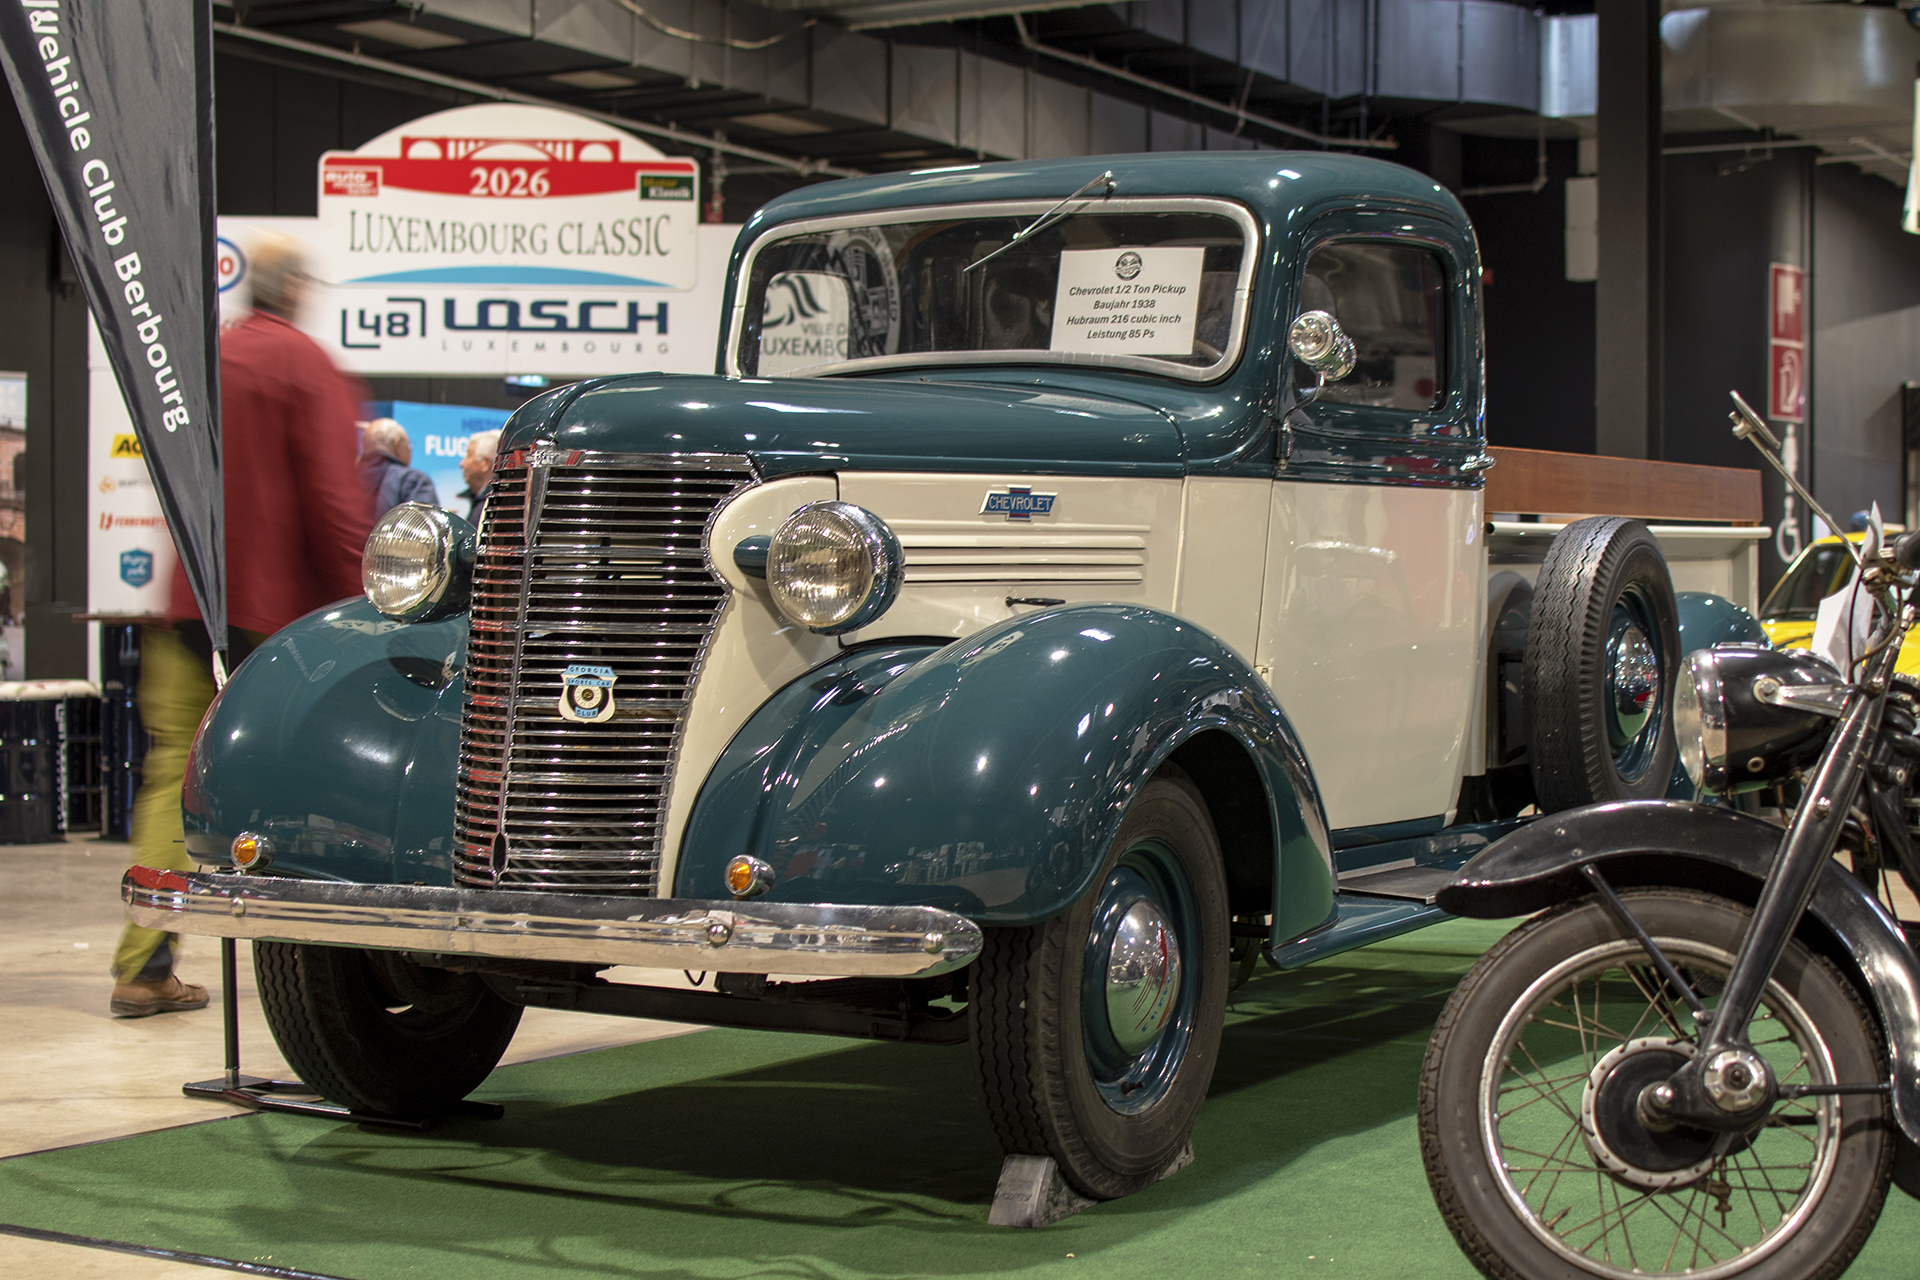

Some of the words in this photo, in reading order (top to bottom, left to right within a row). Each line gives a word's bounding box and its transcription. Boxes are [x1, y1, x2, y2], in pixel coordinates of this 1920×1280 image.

[468, 166, 551, 198] 2026
[649, 186, 692, 199] Klassik
[28, 10, 91, 152] Vehicle
[82, 159, 127, 246] Club
[114, 251, 190, 433] Berbourg
[349, 209, 548, 256] LUXEMBOURG
[557, 214, 672, 256] CLASSIC
[1069, 285, 1114, 296] Chevrolet
[1115, 284, 1132, 294] 1/2
[1133, 284, 1150, 294] Ton
[1152, 284, 1186, 296] Pickup
[1093, 299, 1130, 311] Baujahr
[1131, 299, 1156, 309] 1938
[443, 297, 669, 335] LOSCH
[1066, 315, 1109, 326] Hubraum
[1110, 314, 1129, 324] 216
[1130, 313, 1158, 324] cubic
[1158, 313, 1182, 324] inch
[800, 322, 832, 335] VILLE
[1087, 329, 1128, 341] Leistung
[1128, 329, 1142, 339] 85
[1142, 328, 1155, 339] Ps
[441, 339, 669, 355] LUXEMBOURG
[760, 336, 848, 357] UXEMBO
[988, 495, 1053, 511] CHEVROLET
